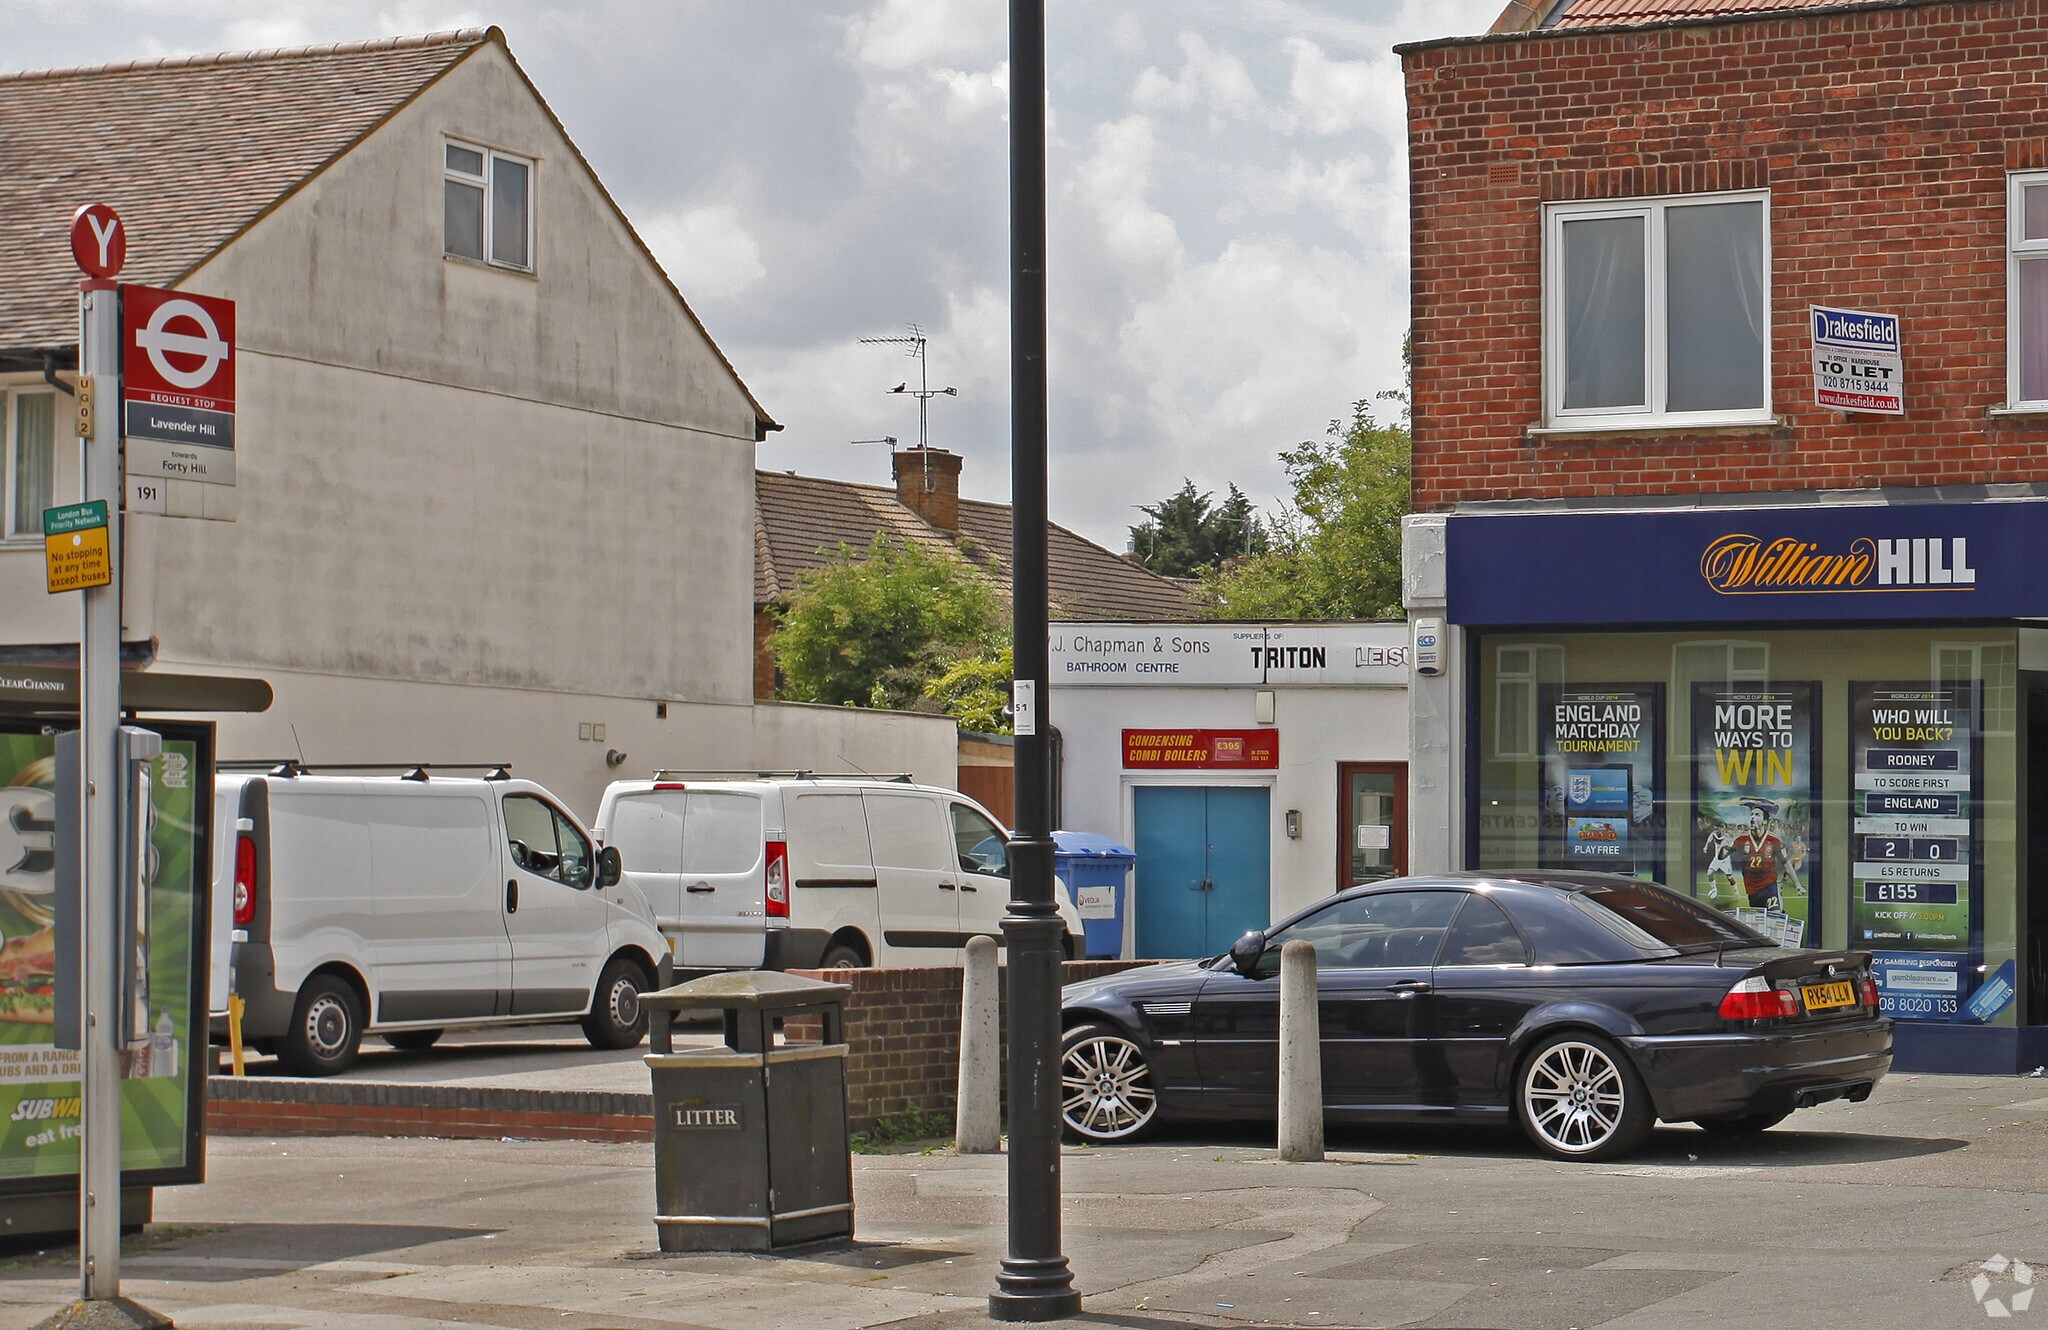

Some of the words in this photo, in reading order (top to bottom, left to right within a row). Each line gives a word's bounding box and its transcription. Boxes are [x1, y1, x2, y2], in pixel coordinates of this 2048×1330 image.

[87, 214, 117, 268] Y
[1814, 311, 1895, 342] Drakesfield
[1851, 358, 1880, 366] WAREHOUSE
[1819, 360, 1844, 374] TO
[1851, 365, 1893, 379] LET
[1824, 376, 1838, 388] 020
[1840, 378, 1862, 391] 8715
[1864, 380, 1889, 392] 9444
[151, 393, 190, 405] REQUEST
[194, 399, 215, 409] STOP
[1819, 393, 1898, 409] www.drakesfield.co.uk
[151, 417, 197, 433] Lavender
[199, 424, 216, 435] Hill
[171, 451, 198, 460] towards
[162, 460, 188, 474] Forty
[191, 463, 207, 474] Hill
[137, 486, 157, 500] 191
[58, 510, 80, 520] London
[81, 508, 93, 516] Bus
[51, 520, 73, 530] Priority
[74, 516, 100, 526] Network
[52, 552, 64, 562] No
[66, 548, 102, 560] stopping
[1701, 534, 1876, 587] William
[1878, 537, 1975, 585] HILL
[54, 565, 62, 574] at
[65, 564, 80, 572] any
[82, 560, 102, 570] time
[50, 574, 78, 586] except
[82, 572, 106, 582] buses
[1074, 636, 1145, 656] Chapman
[1153, 636, 1163, 653] &
[1171, 637, 1210, 654] Sons
[1250, 646, 1327, 669] TRITON
[1066, 662, 1127, 672] BATHROOM
[1135, 662, 1180, 673] CENTRE
[1555, 704, 1641, 722] ENGLAND
[1715, 705, 1792, 730] MORE
[1872, 709, 1910, 724] WHO
[1914, 710, 1952, 724] WILL
[1555, 724, 1640, 739] MATCHDAY
[1872, 727, 1902, 740] YOU
[1906, 727, 1952, 740] BACK?
[1128, 735, 1194, 746] CONDENSING
[1216, 742, 1240, 750] £395
[1556, 740, 1640, 752] TOURNAMENT
[1714, 732, 1764, 748] WAYS
[1769, 732, 1793, 748] TO
[1129, 750, 1160, 762] COMBI
[1164, 750, 1208, 762] BOILERS
[1888, 755, 1936, 766] ROONEY
[1715, 750, 1792, 786] WIN
[1874, 778, 1886, 787] TO
[1889, 778, 1920, 788] SCORE
[1923, 779, 1950, 788] FIRST
[1884, 798, 1939, 809] ENGLAND
[1895, 822, 1908, 832] TO
[1910, 823, 1928, 832] WIN
[1574, 846, 1596, 854] PLAY
[1598, 846, 1620, 854] FREE
[1885, 842, 1896, 857] 2
[1930, 844, 1940, 860] 0
[1882, 868, 1894, 876] £5
[1896, 868, 1940, 877] RETURNS
[1878, 884, 1918, 900] £155
[1874, 911, 1892, 919] KICK
[1884, 958, 1918, 966] GAMBLING
[1879, 997, 1895, 1010] 08
[1899, 998, 1932, 1012] 8020
[1936, 999, 1958, 1013] 133
[32, 1052, 38, 1062] A
[42, 1050, 80, 1061] RANGE
[0, 1065, 22, 1076] UBS
[24, 1064, 48, 1076] AND
[52, 1064, 58, 1074] A
[62, 1063, 82, 1074] DRI
[10, 1097, 82, 1120] SUBWA
[676, 1109, 737, 1126] LITTER
[26, 1128, 56, 1148] eat
[60, 1124, 82, 1140] fre
